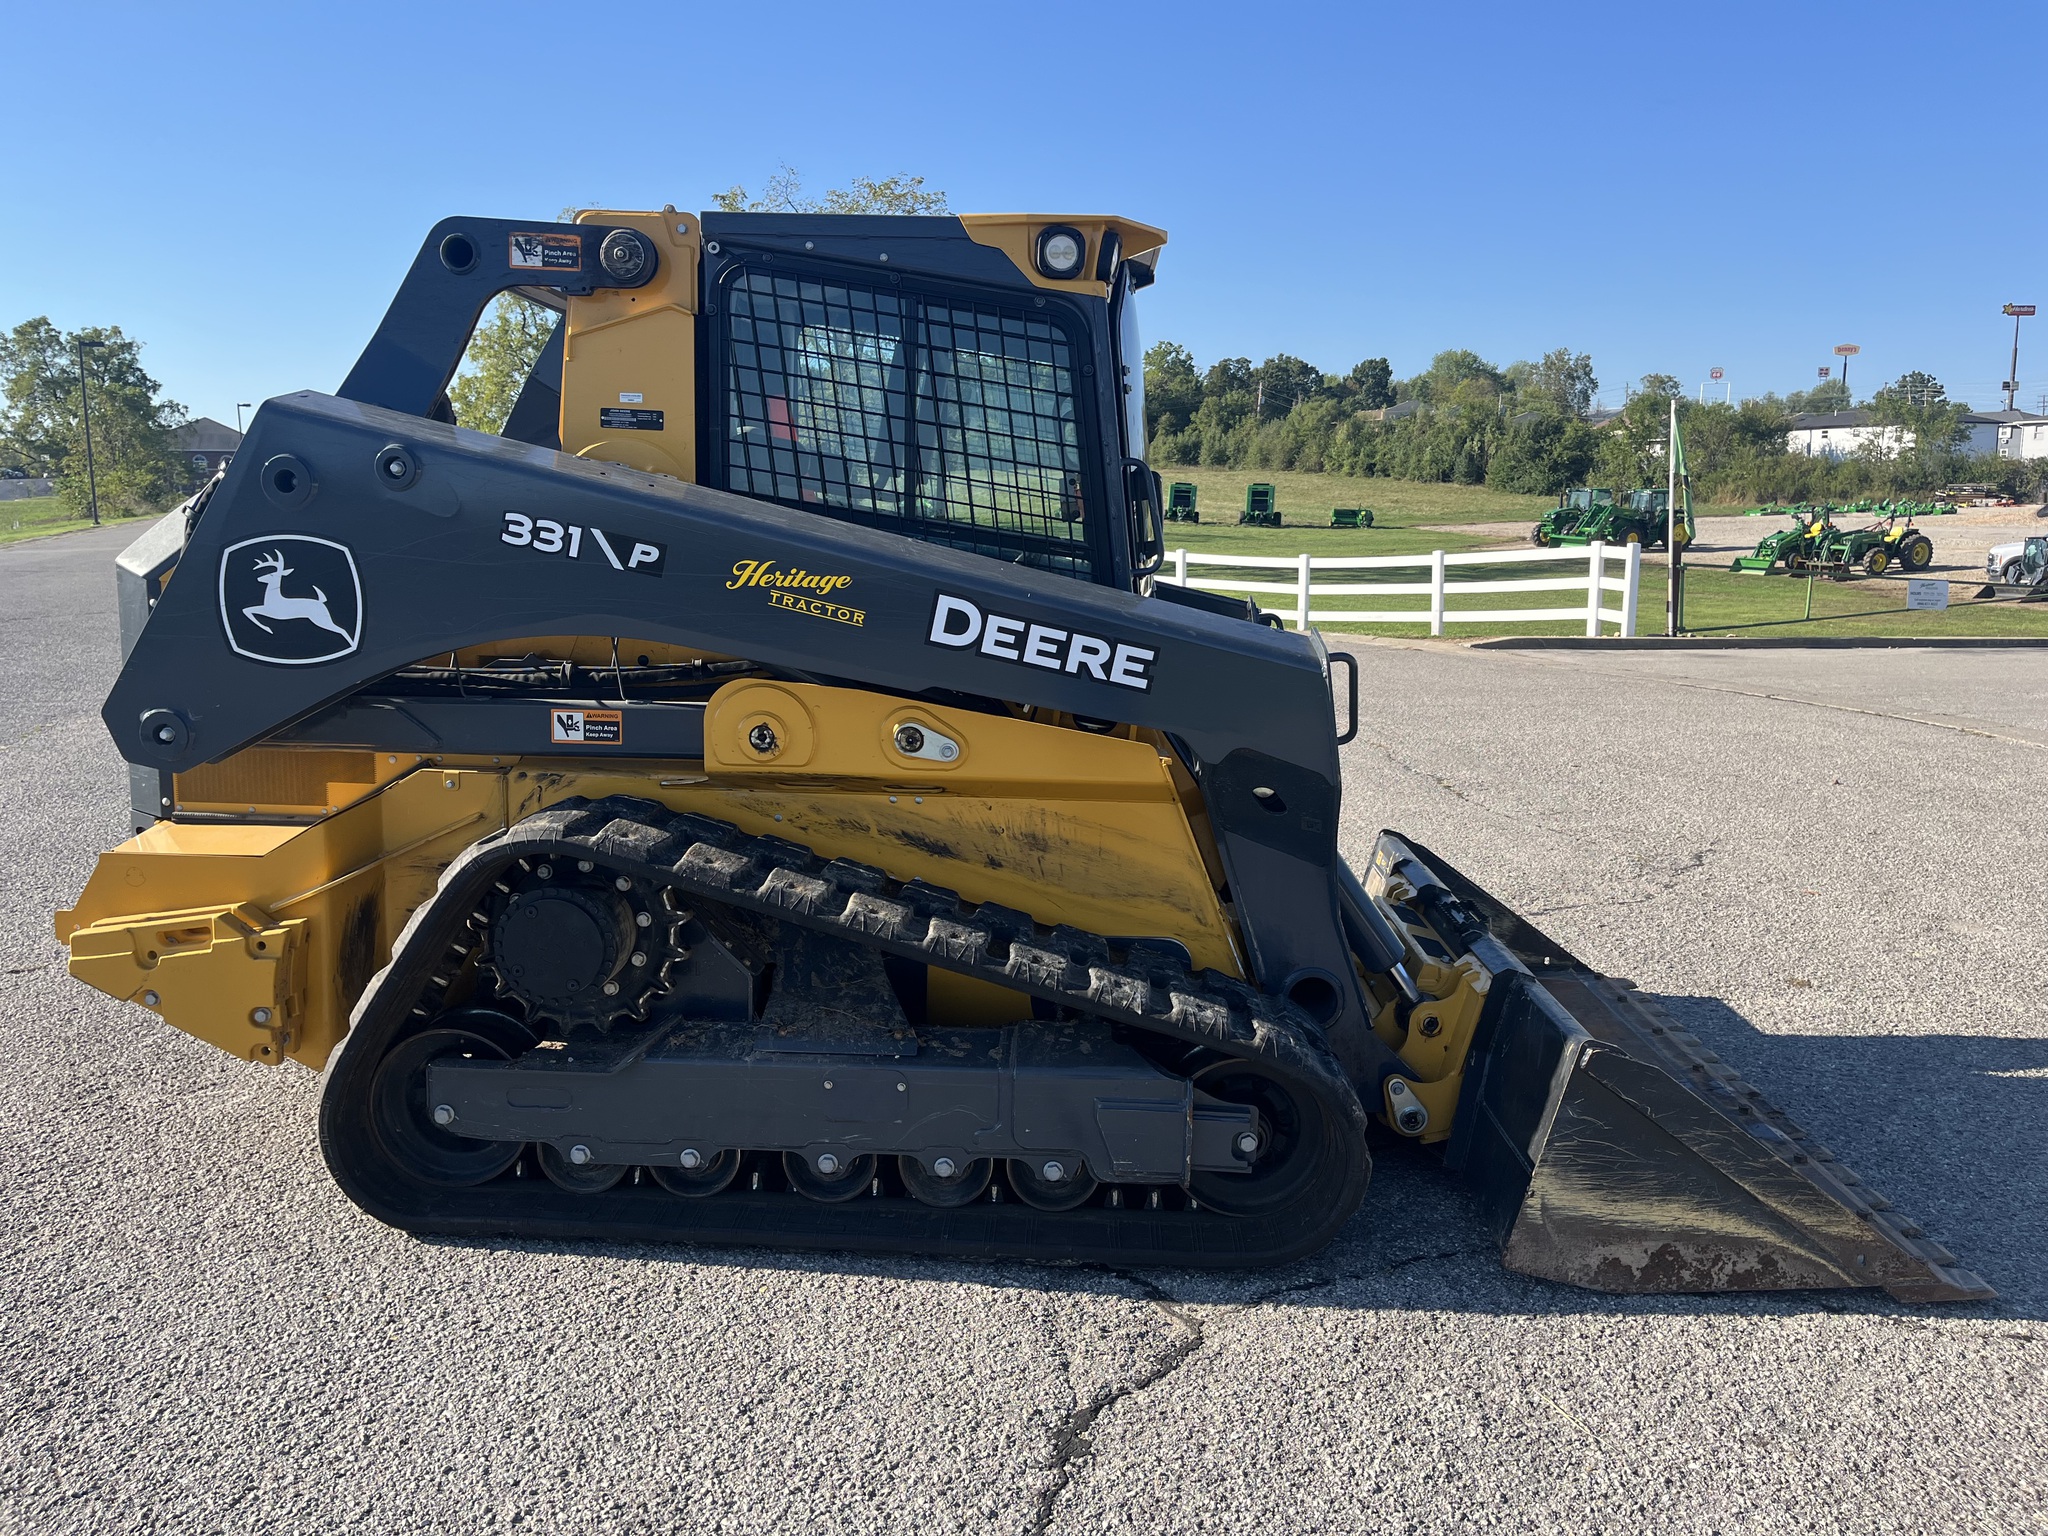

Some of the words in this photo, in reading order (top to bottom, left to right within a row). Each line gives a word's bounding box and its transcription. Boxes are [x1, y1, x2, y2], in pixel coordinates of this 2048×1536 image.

[501, 512, 582, 559] 331
[725, 560, 853, 595] Heritage
[769, 592, 865, 625] TRACTOR
[930, 594, 1155, 690] DEERE
